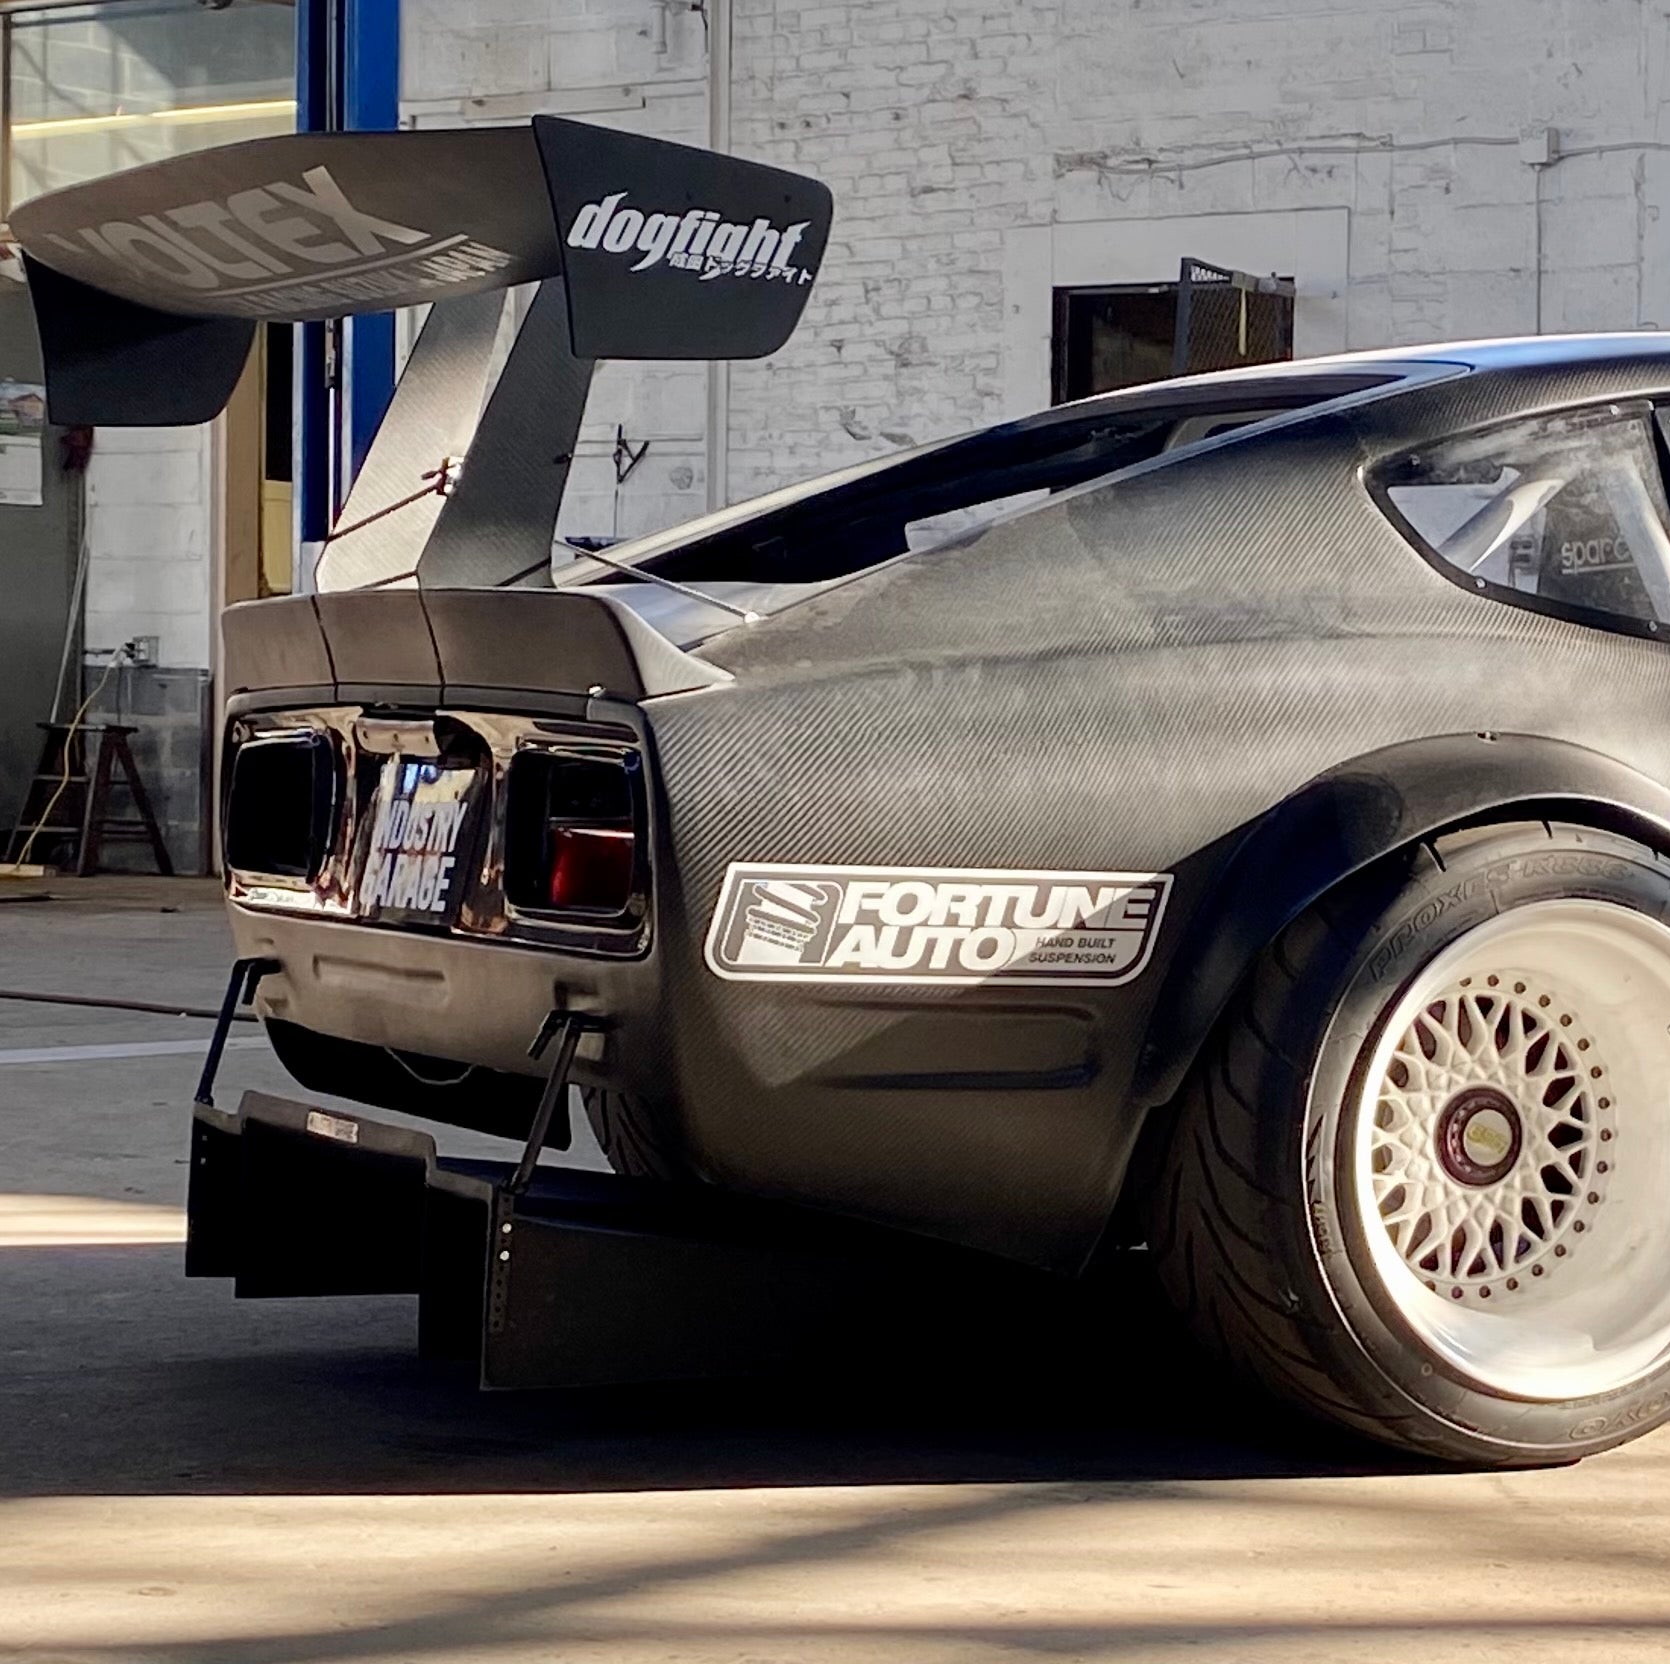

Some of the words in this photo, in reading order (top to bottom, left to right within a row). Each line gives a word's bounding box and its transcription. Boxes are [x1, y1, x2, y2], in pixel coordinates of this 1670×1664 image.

[42, 165, 431, 288] VOLTEX
[567, 191, 812, 281] dogfight
[1561, 537, 1633, 575] sparc
[838, 880, 1150, 929] FORTUNE
[834, 926, 1015, 970] AUTO
[1028, 952, 1117, 964] SUSPENSION
[1035, 937, 1074, 949] HAND
[1077, 937, 1116, 949] BUILT
